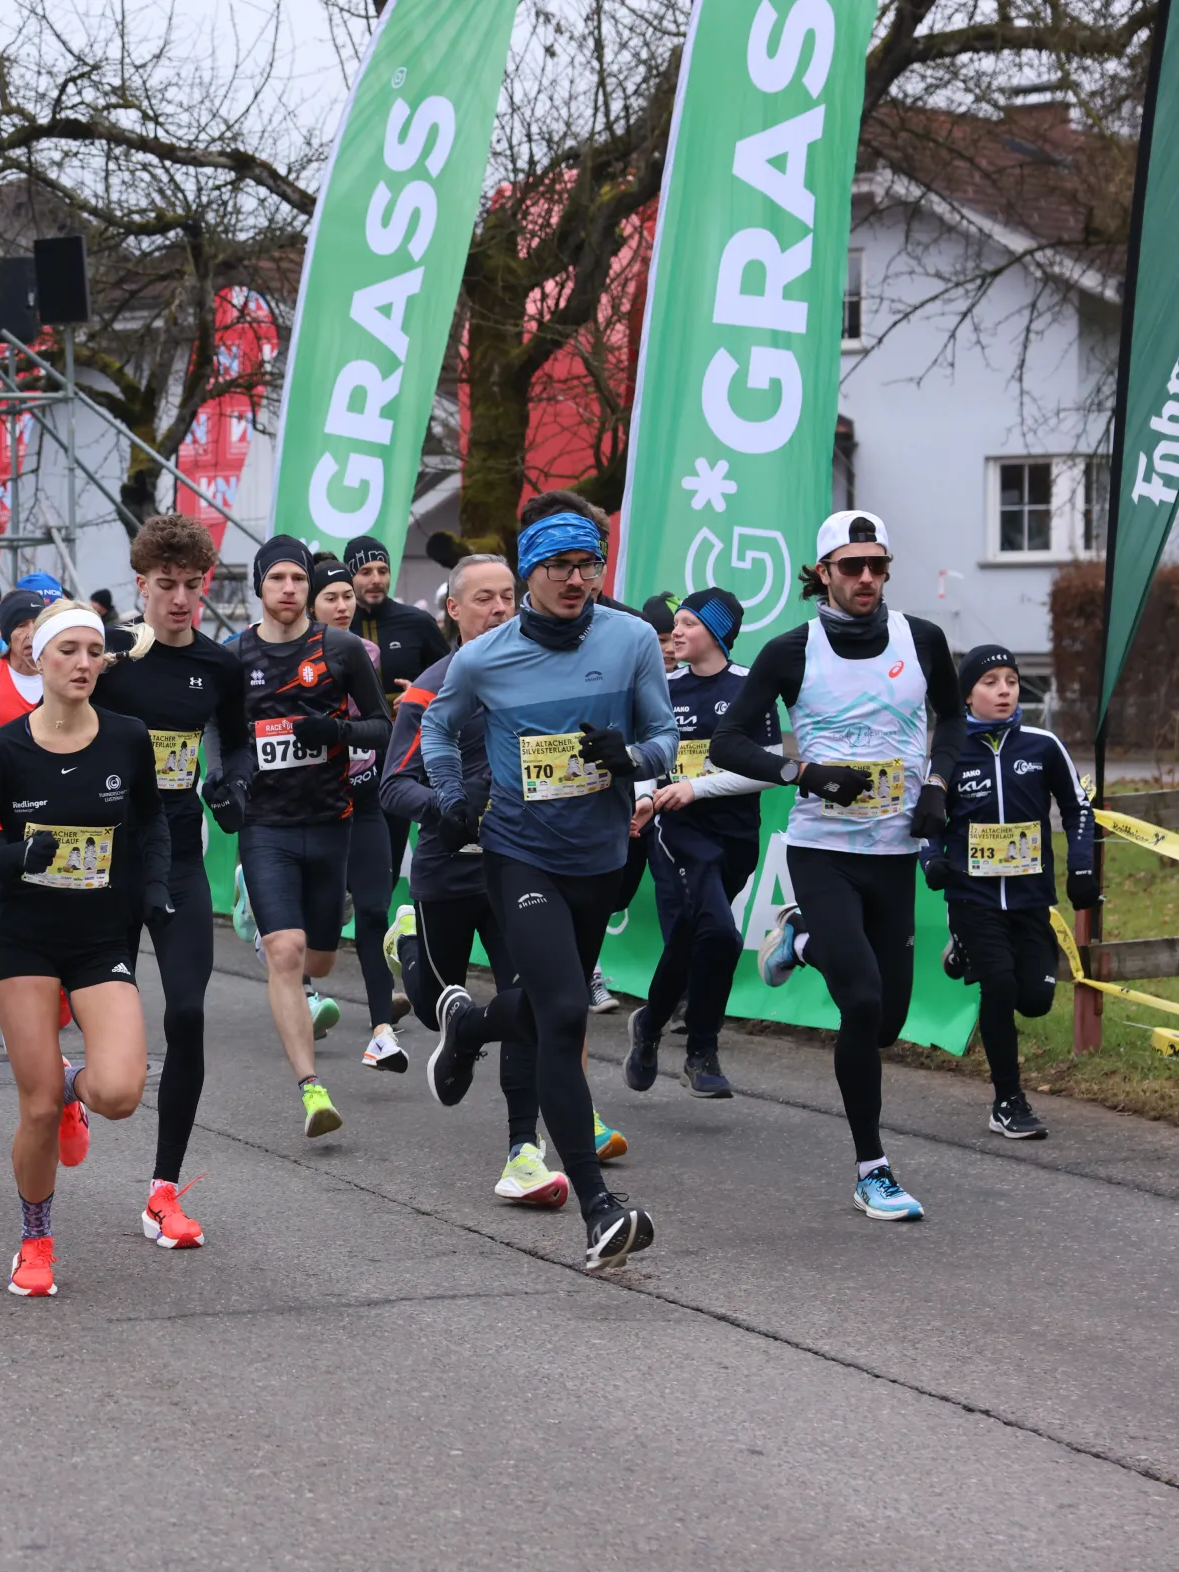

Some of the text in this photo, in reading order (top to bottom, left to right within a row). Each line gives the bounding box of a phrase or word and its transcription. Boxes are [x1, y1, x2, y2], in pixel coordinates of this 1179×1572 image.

[308, 95, 455, 538] GRASS
[266, 723, 282, 732] RACE
[535, 738, 573, 748] ALTACHER
[521, 746, 576, 756] SILVESTERLAUF
[524, 764, 554, 779] 170
[962, 769, 981, 779] JAKO
[958, 779, 992, 792] KIA
[12, 799, 48, 809] Redlinger
[970, 847, 995, 859] 213
[518, 897, 548, 909] skinfit
